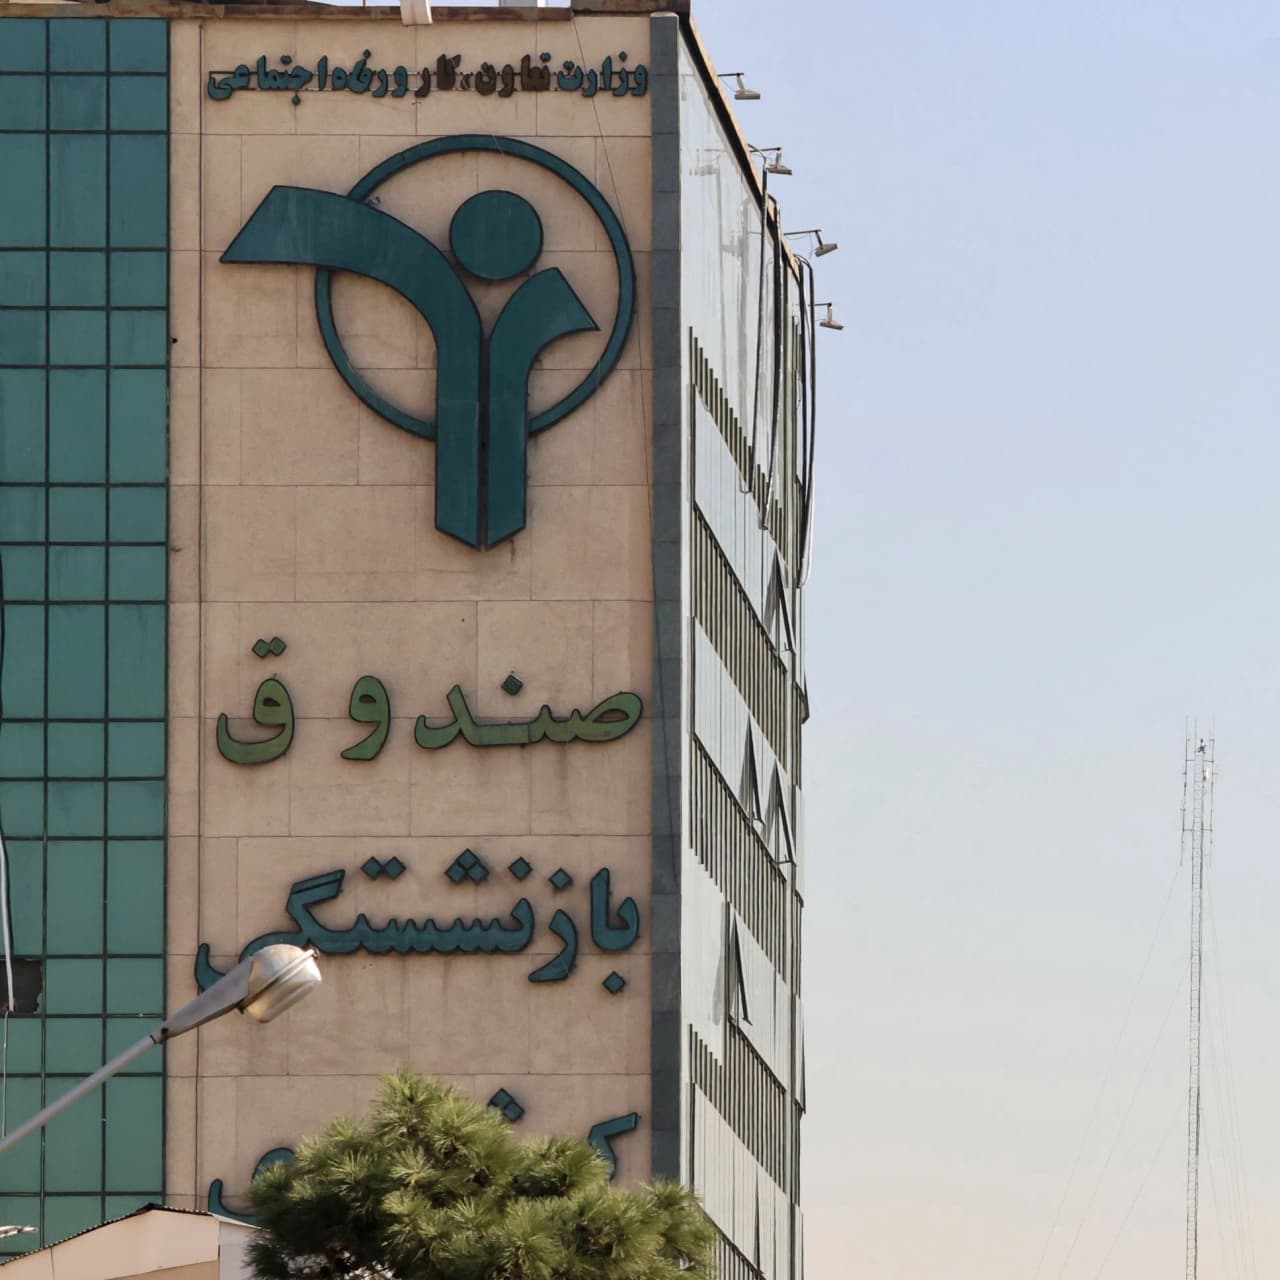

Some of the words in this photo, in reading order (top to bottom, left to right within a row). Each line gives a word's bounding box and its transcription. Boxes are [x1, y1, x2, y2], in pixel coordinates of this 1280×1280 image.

[207, 54, 328, 107] اجتماعی
[332, 49, 387, 98] رفاه
[414, 53, 461, 98] کار
[556, 50, 648, 97] وزارت
